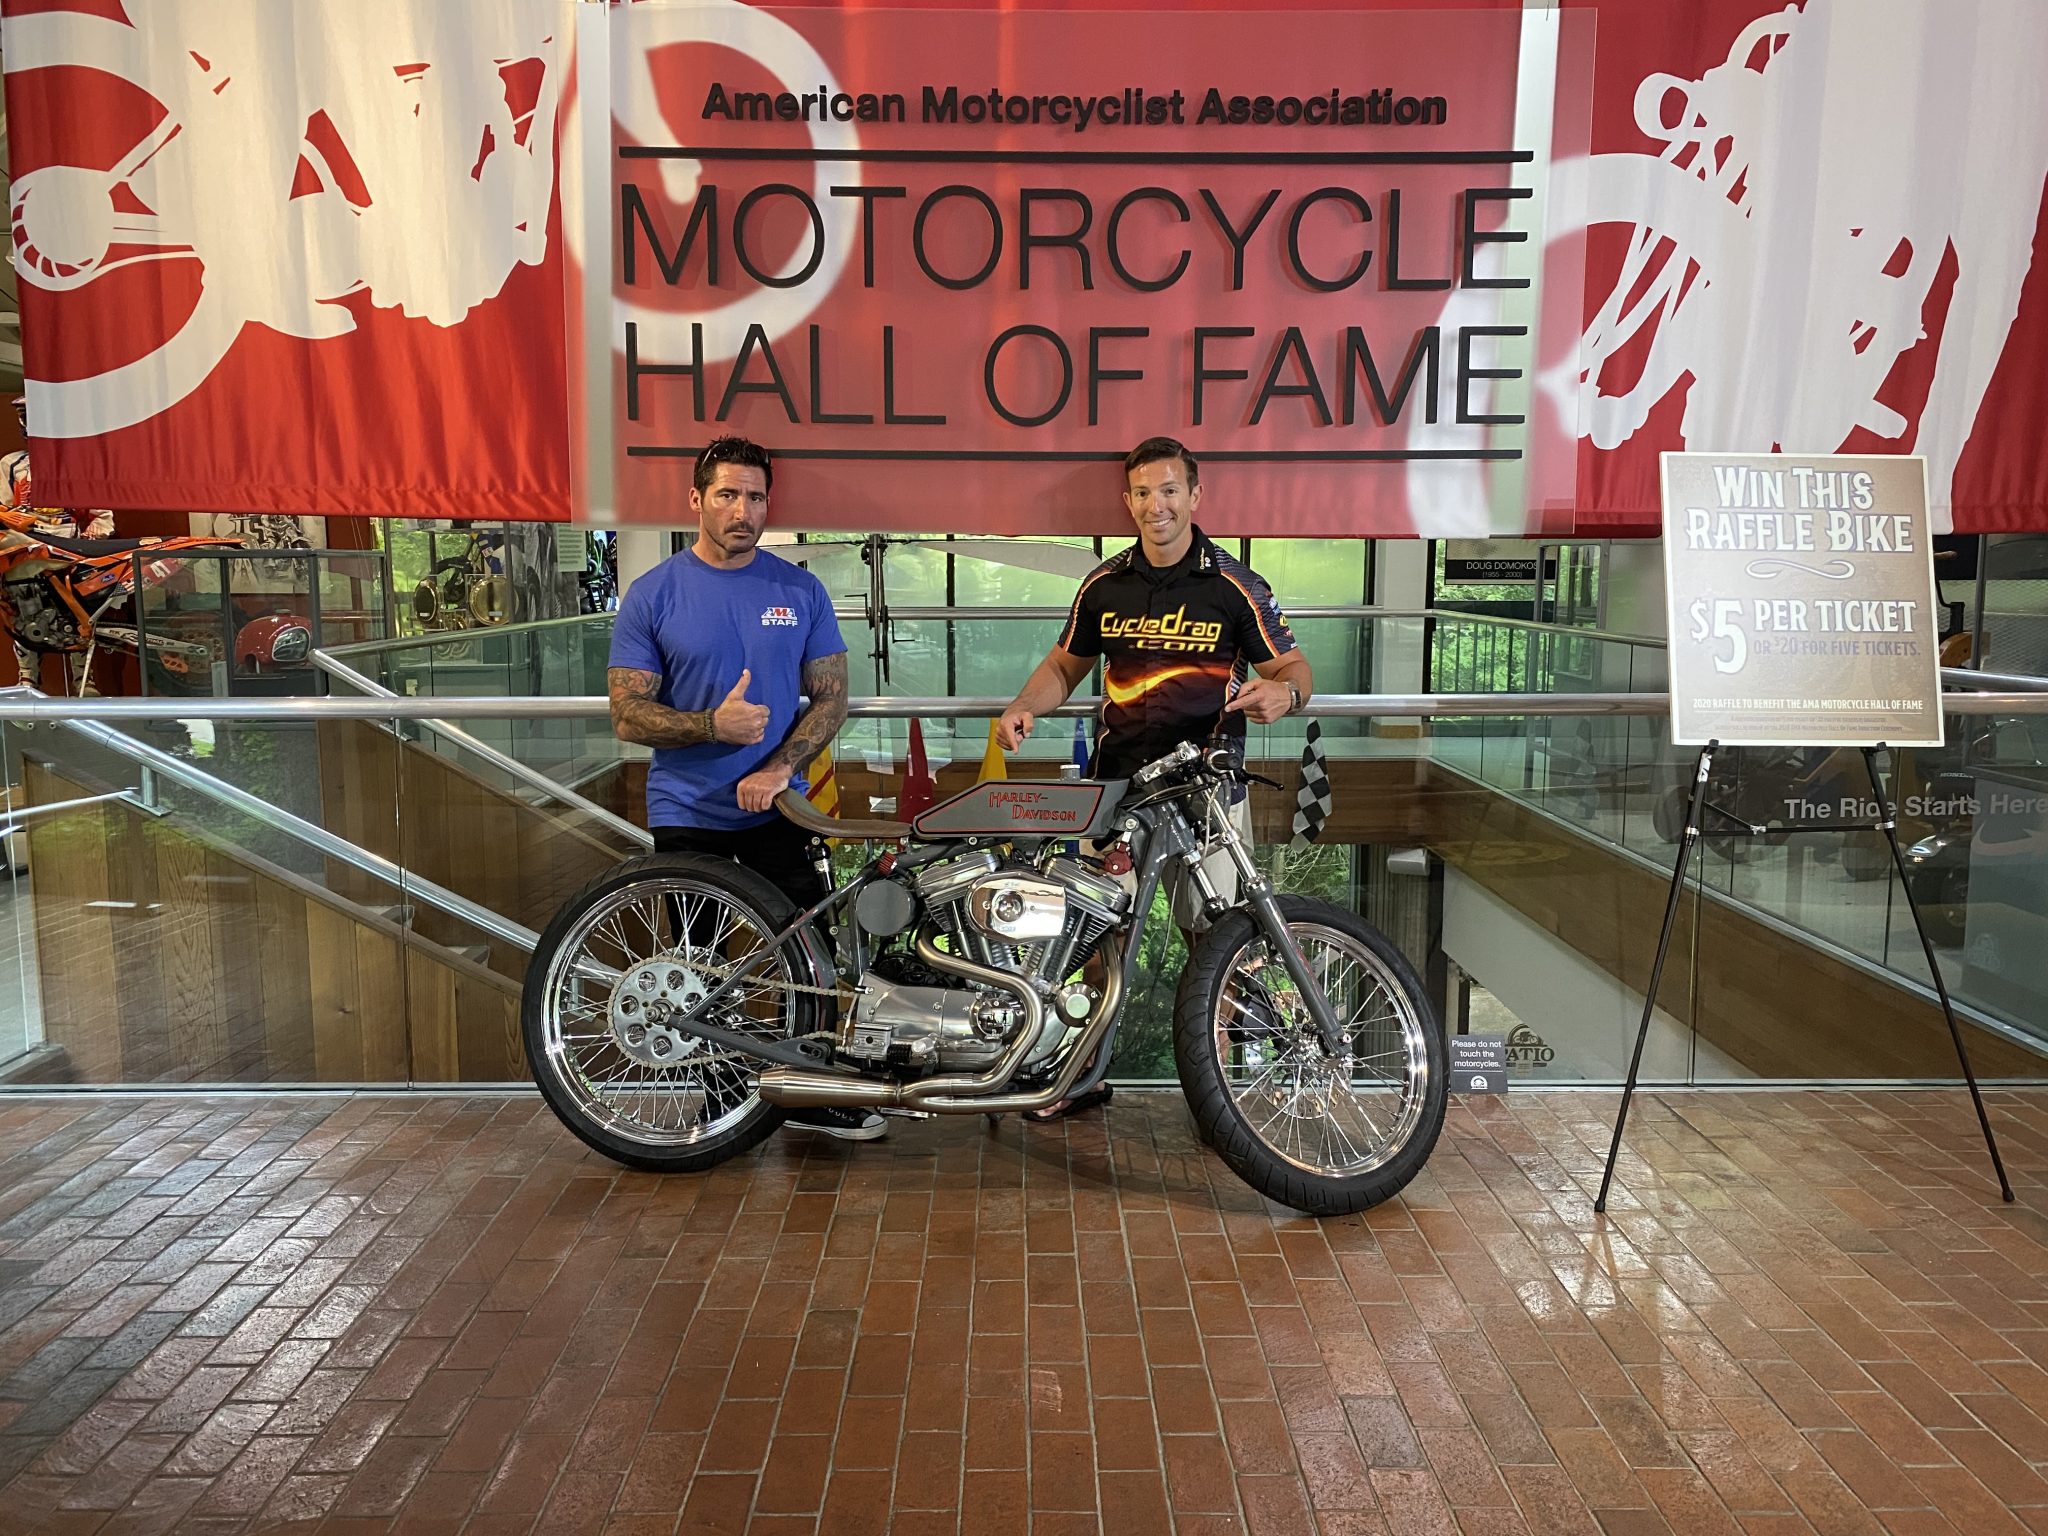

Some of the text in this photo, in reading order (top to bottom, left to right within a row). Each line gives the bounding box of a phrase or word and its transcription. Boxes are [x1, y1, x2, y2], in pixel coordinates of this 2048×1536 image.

[701, 82, 1448, 133] American Motorcyclist Association
[620, 183, 1534, 292] MOTORCYCLE
[625, 321, 1529, 428] HALL OF FAME
[1712, 465, 1875, 510] WIN THIS
[1685, 508, 1915, 553] RAFFLE BIKE
[1466, 561, 1493, 570] DOUG
[761, 606, 798, 620] AMA
[761, 618, 798, 627] STAFF
[1689, 598, 1918, 676] $5 PER TICKET
[1753, 640, 1771, 656] OR
[1802, 641, 1827, 656] FOR
[1831, 641, 1860, 656] FIVE
[1863, 641, 1921, 657] TICKETS.
[1713, 698, 1741, 709] RAFFLE
[1743, 698, 1752, 709] TO
[1754, 698, 1784, 709] BENEFIT
[1786, 698, 1802, 709] THE
[1803, 698, 1820, 709] AMA
[1821, 699, 1870, 710] MOTORCYCLE
[1871, 699, 1891, 710] HALL
[1892, 699, 1902, 710] OF
[1902, 699, 1923, 710] FAME
[988, 791, 1049, 808] HARLEY-
[1784, 798, 1832, 819] The
[1904, 795, 1982, 817] Starts
[1011, 804, 1077, 822] DAVIDSON
[1451, 1039, 1502, 1048] Please do not
[1460, 1049, 1495, 1058] touch the
[1505, 1047, 1555, 1062] ATIO
[1454, 1060, 1501, 1069] motorcycles.
